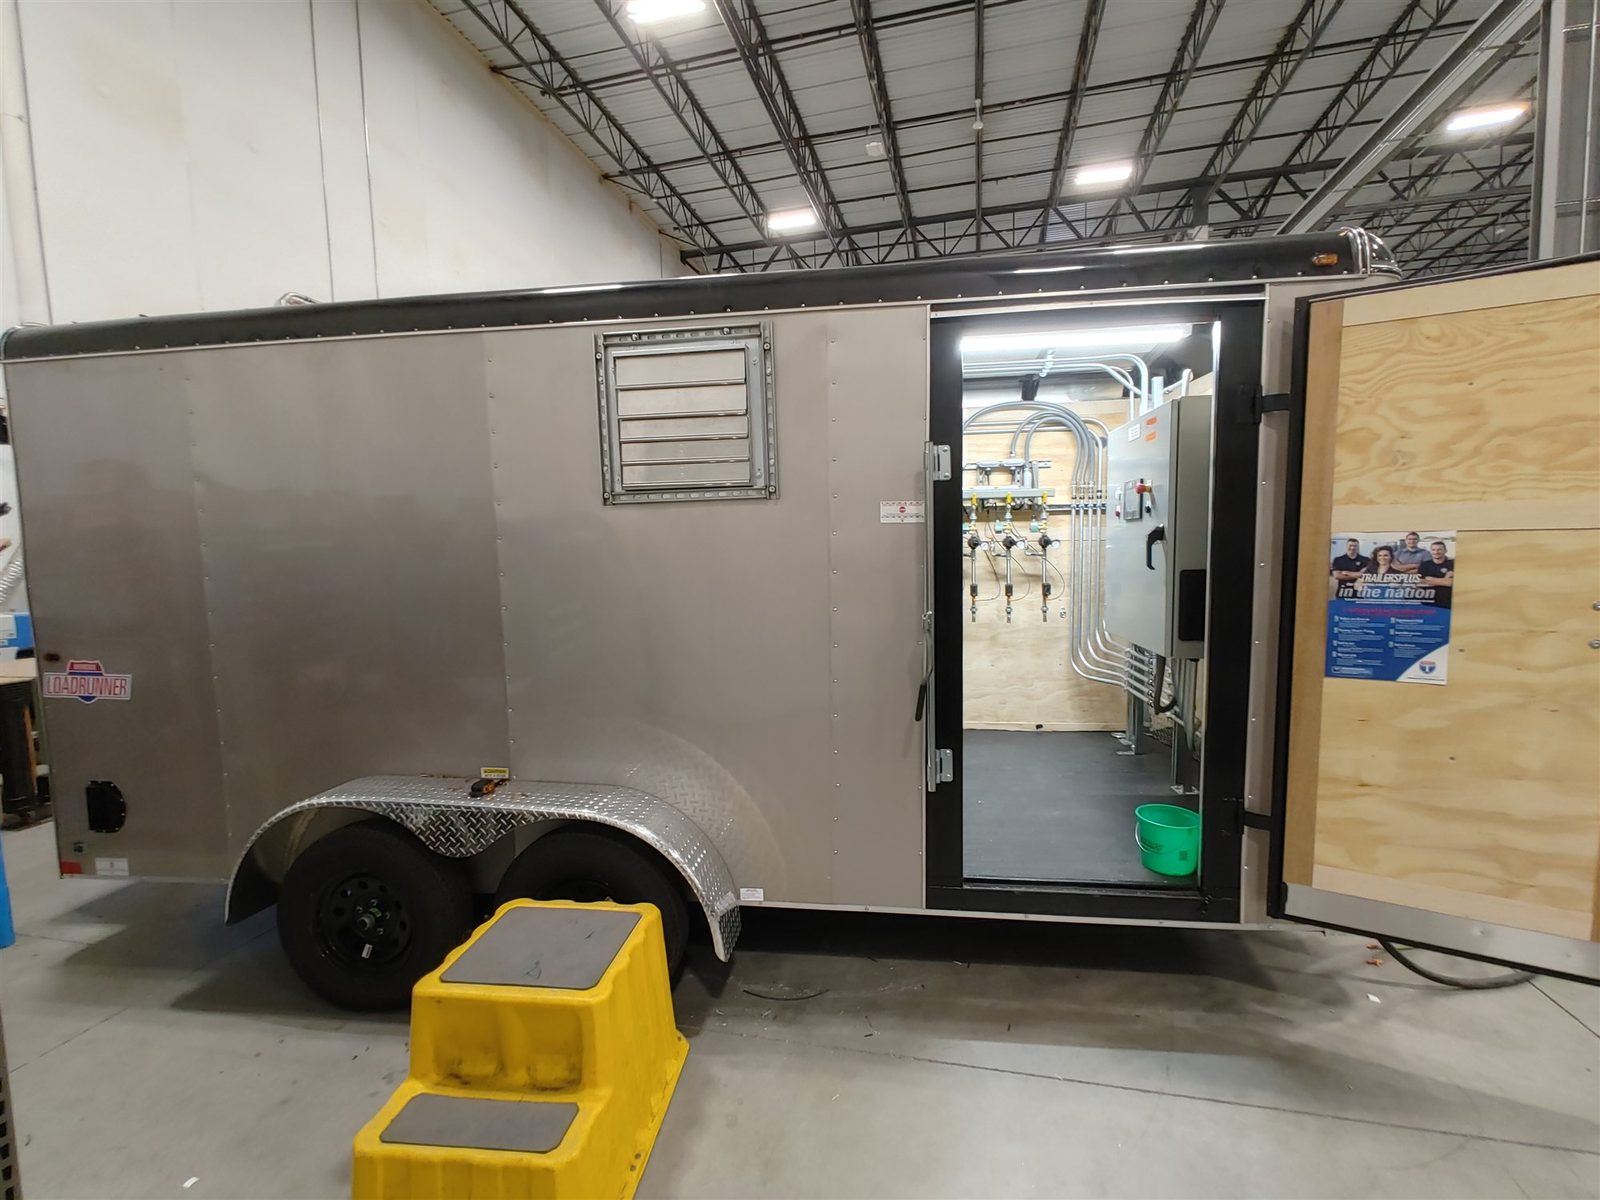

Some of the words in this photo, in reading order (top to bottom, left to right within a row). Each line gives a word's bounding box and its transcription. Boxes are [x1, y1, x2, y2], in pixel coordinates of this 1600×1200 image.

[1361, 573, 1422, 583] TRAILERSPLUS
[1339, 584, 1354, 597] in
[1356, 585, 1381, 598] the
[1384, 586, 1435, 598] nation
[47, 676, 127, 695] LOADRUNNER
